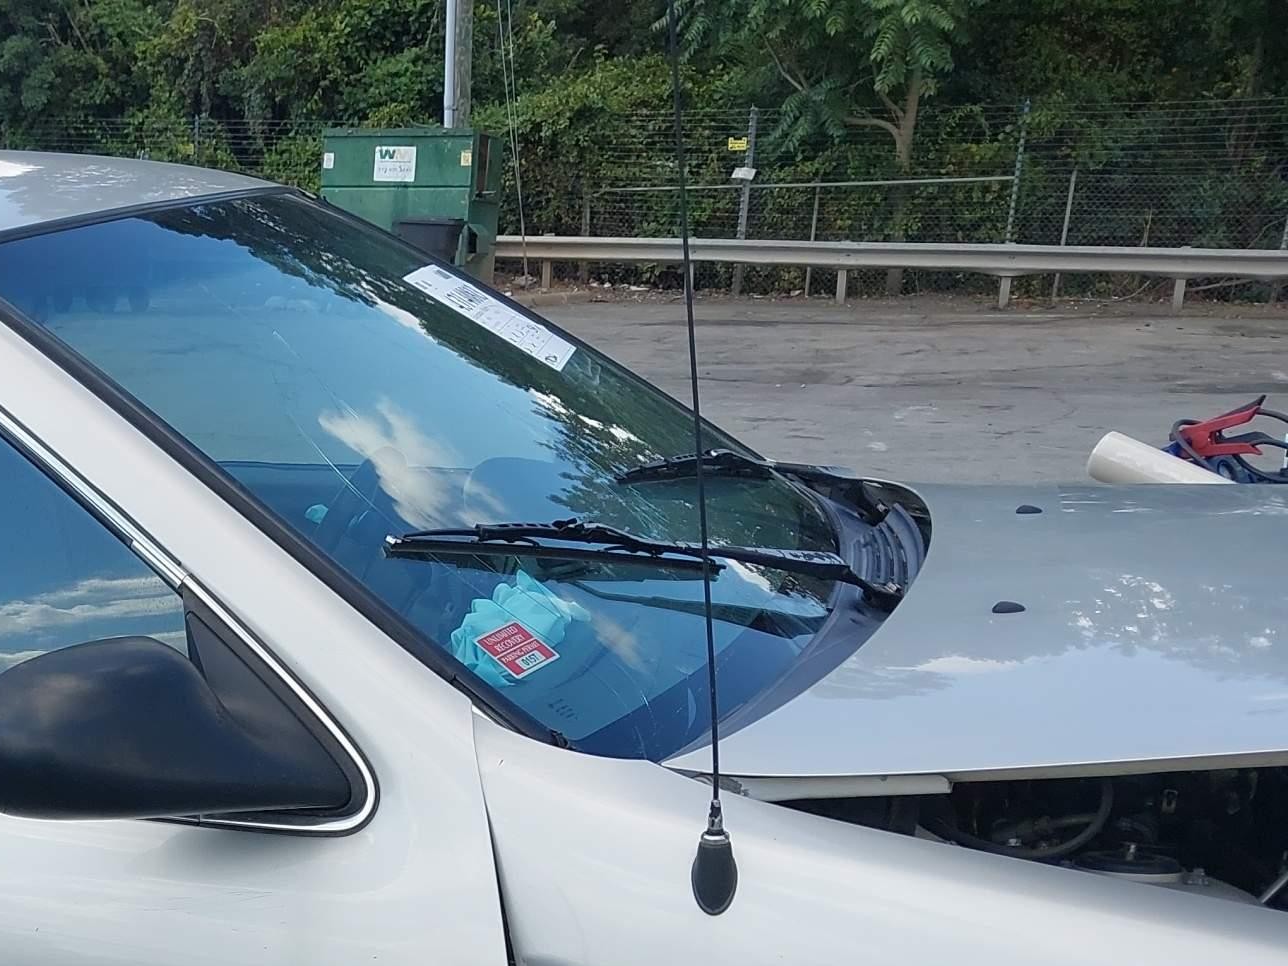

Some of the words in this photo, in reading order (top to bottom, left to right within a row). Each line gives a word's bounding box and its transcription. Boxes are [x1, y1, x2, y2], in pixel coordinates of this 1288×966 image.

[483, 626, 518, 646] UNLIMITED
[494, 633, 526, 653] RECOVERY
[500, 648, 524, 664] PARKING
